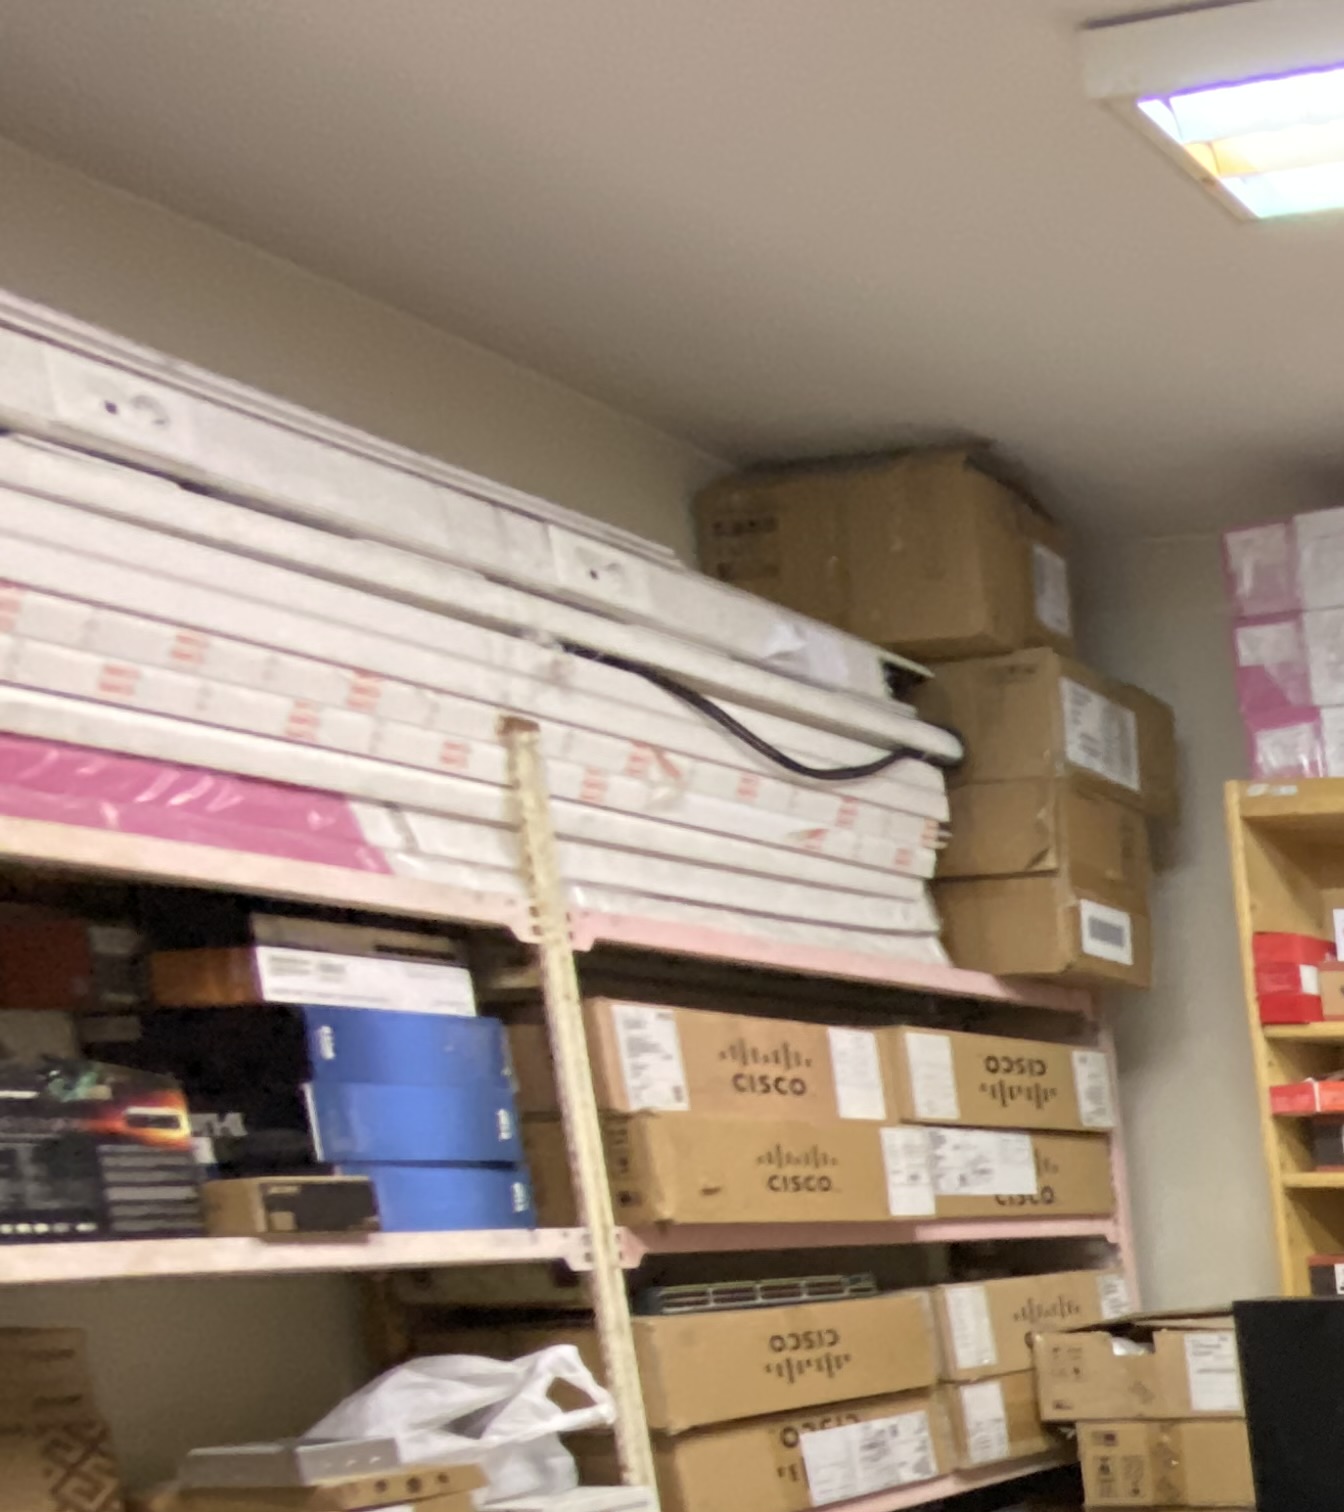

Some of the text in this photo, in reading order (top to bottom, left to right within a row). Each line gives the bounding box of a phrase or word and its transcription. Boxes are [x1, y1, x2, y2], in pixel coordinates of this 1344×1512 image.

[984, 1053, 1047, 1076] CISCO
[732, 1072, 807, 1096] CISCO
[767, 1174, 832, 1193] CISCO
[769, 1329, 840, 1353] CISCO
